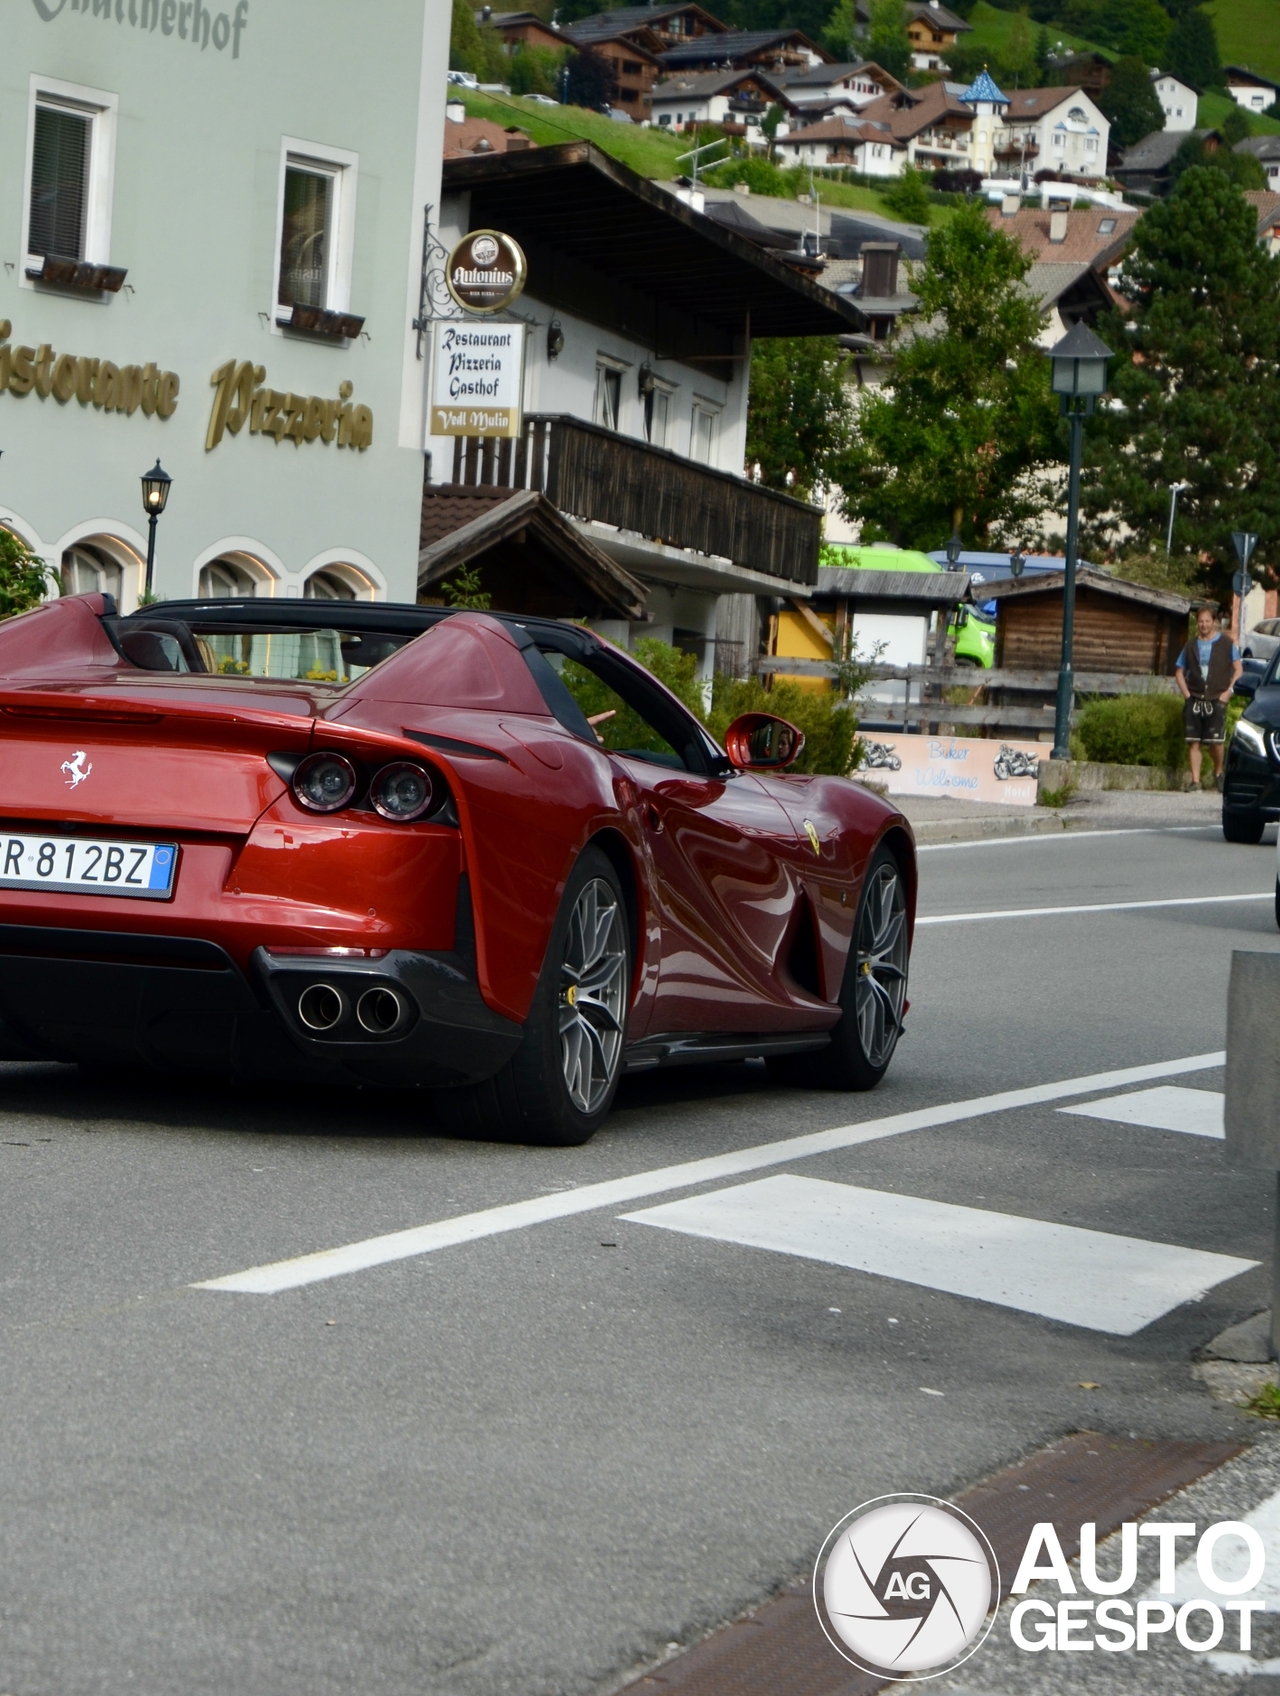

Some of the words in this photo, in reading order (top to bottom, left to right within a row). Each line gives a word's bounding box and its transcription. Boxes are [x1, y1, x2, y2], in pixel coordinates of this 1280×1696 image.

[453, 267, 513, 285] Antonius
[442, 328, 511, 351] Restaurant
[449, 352, 502, 375] Pizzeria
[449, 376, 499, 400] Gasthof
[205, 358, 373, 450] Pizzeria
[437, 410, 466, 430] Vedl
[470, 411, 509, 431] Mulin
[927, 740, 969, 761] Biker
[915, 768, 979, 789] Welcome
[1004, 785, 1031, 798] Hotel
[36, 842, 148, 885] 812BZ
